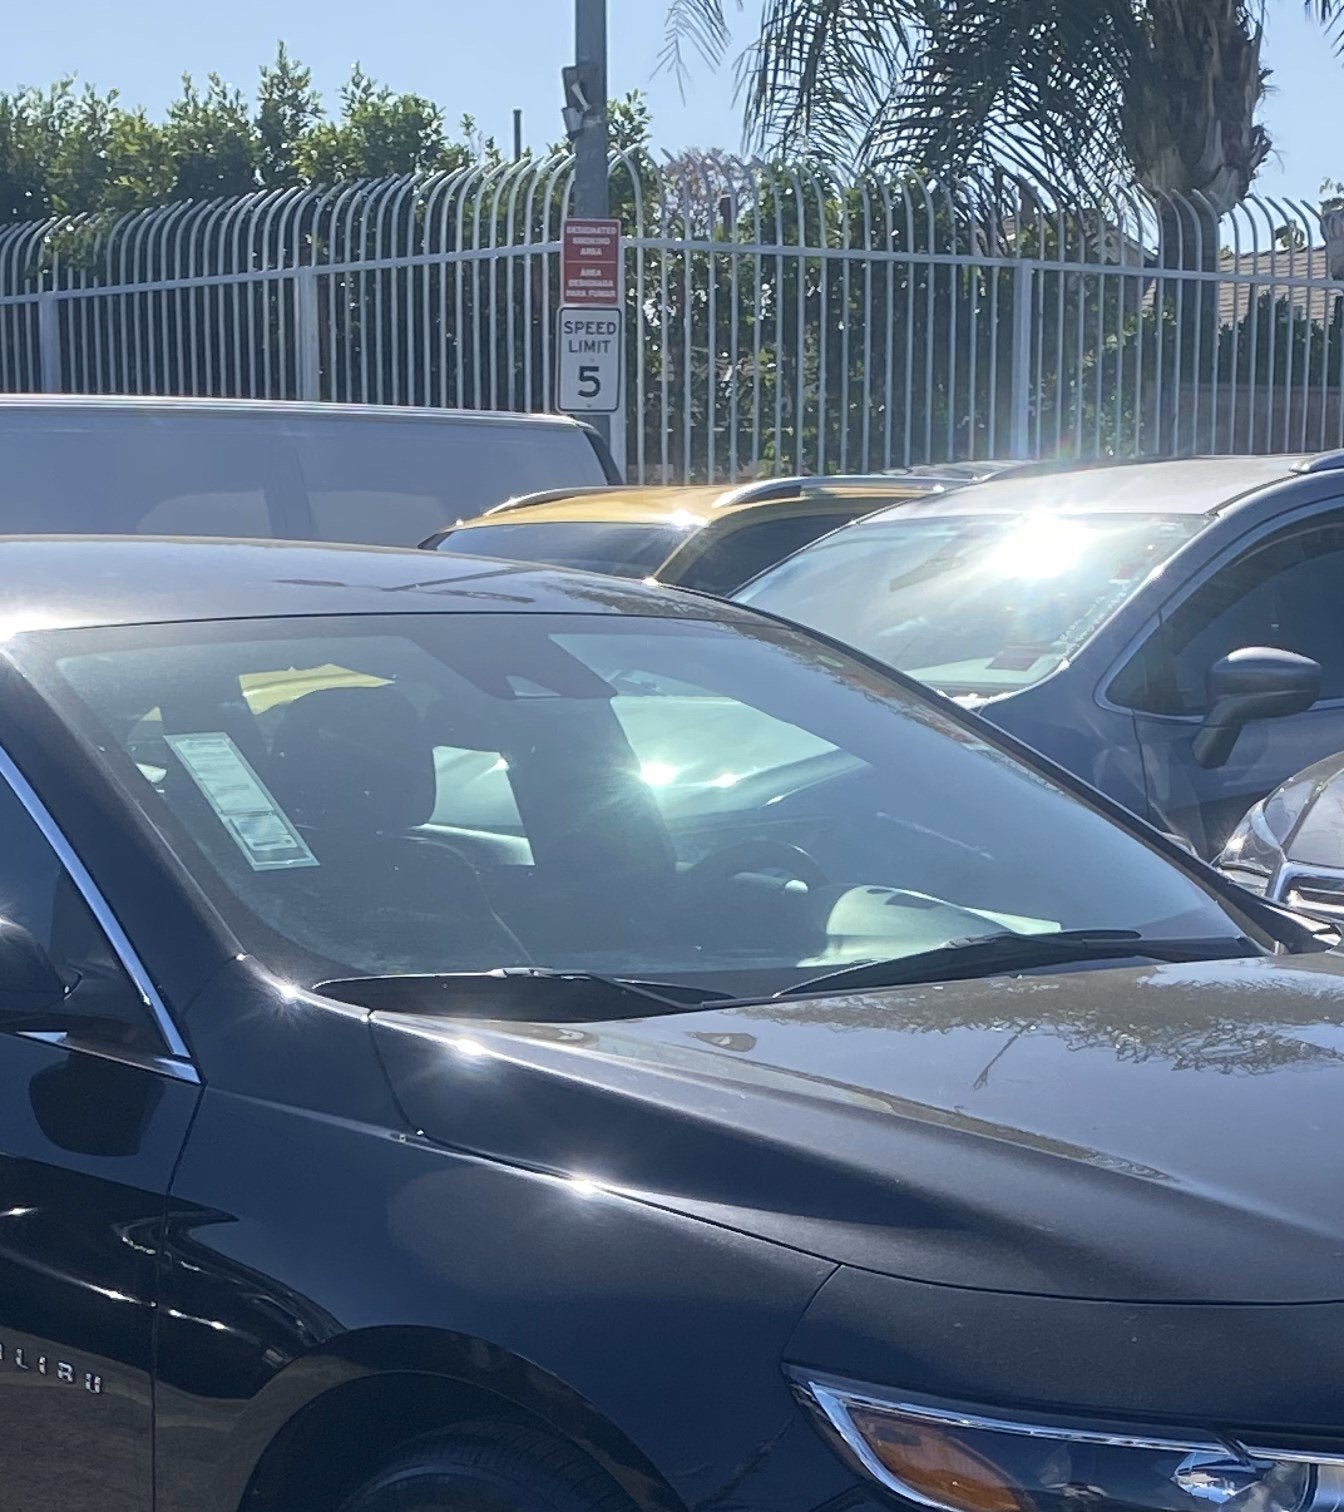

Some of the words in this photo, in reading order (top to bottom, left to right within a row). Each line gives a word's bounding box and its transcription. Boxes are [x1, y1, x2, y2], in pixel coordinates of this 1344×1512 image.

[579, 247, 603, 256] AREA
[563, 320, 617, 335] SPEED
[568, 340, 612, 354] LIMIT
[577, 365, 601, 398] 5
